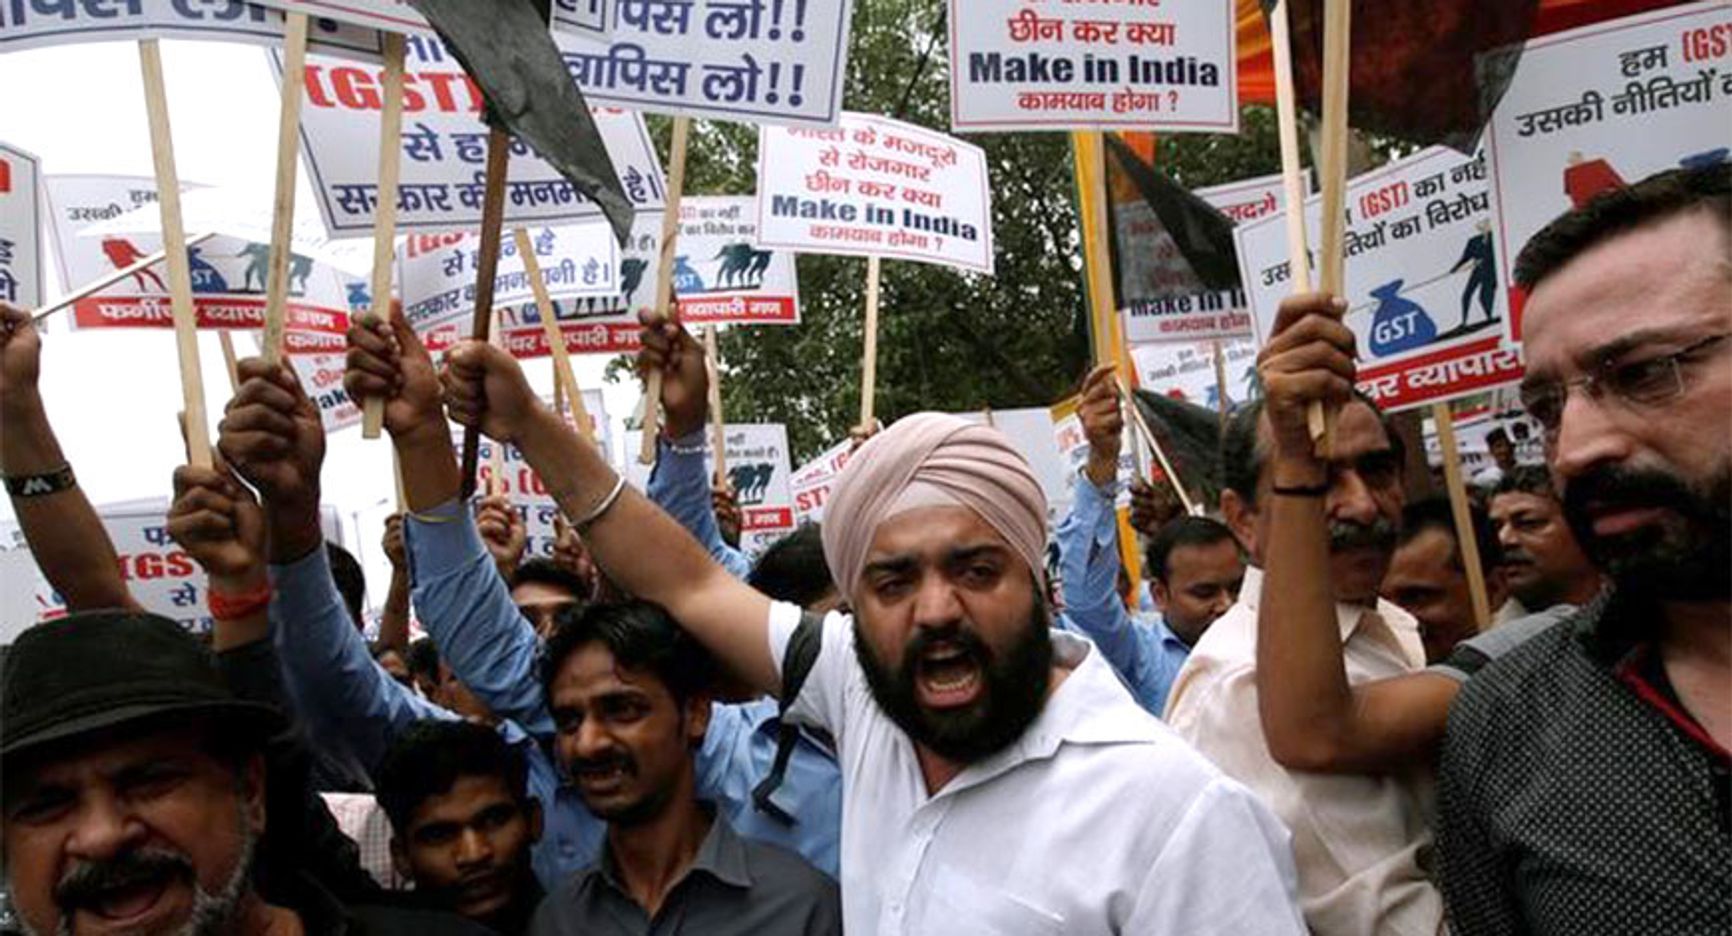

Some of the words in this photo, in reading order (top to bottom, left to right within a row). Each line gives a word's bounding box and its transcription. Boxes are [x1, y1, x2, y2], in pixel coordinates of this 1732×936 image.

[1008, 9, 1063, 42] छीन
[1072, 20, 1120, 45] कर
[1126, 22, 1175, 46] क्या
[969, 53, 1074, 83] Make
[1085, 54, 1120, 83] in
[1128, 56, 1219, 86] India
[1618, 45, 1669, 78] हम
[1112, 86, 1161, 113] होगा
[1168, 90, 1179, 112] ?
[1515, 91, 1606, 137] उसकी
[1611, 68, 1717, 115] नीतियों
[402, 123, 443, 161] से
[853, 126, 876, 146] के
[819, 145, 840, 167] से
[848, 150, 931, 182] रोजगार
[806, 169, 850, 194] छीन
[858, 180, 896, 201] कर
[902, 187, 943, 208] क्या
[1413, 172, 1445, 198] का
[771, 195, 858, 222] Make
[865, 203, 895, 226] in
[902, 209, 978, 241] India
[1391, 216, 1422, 239] का
[1426, 191, 1490, 230] विरोध
[1374, 311, 1419, 345] GST
[168, 581, 196, 607] से
